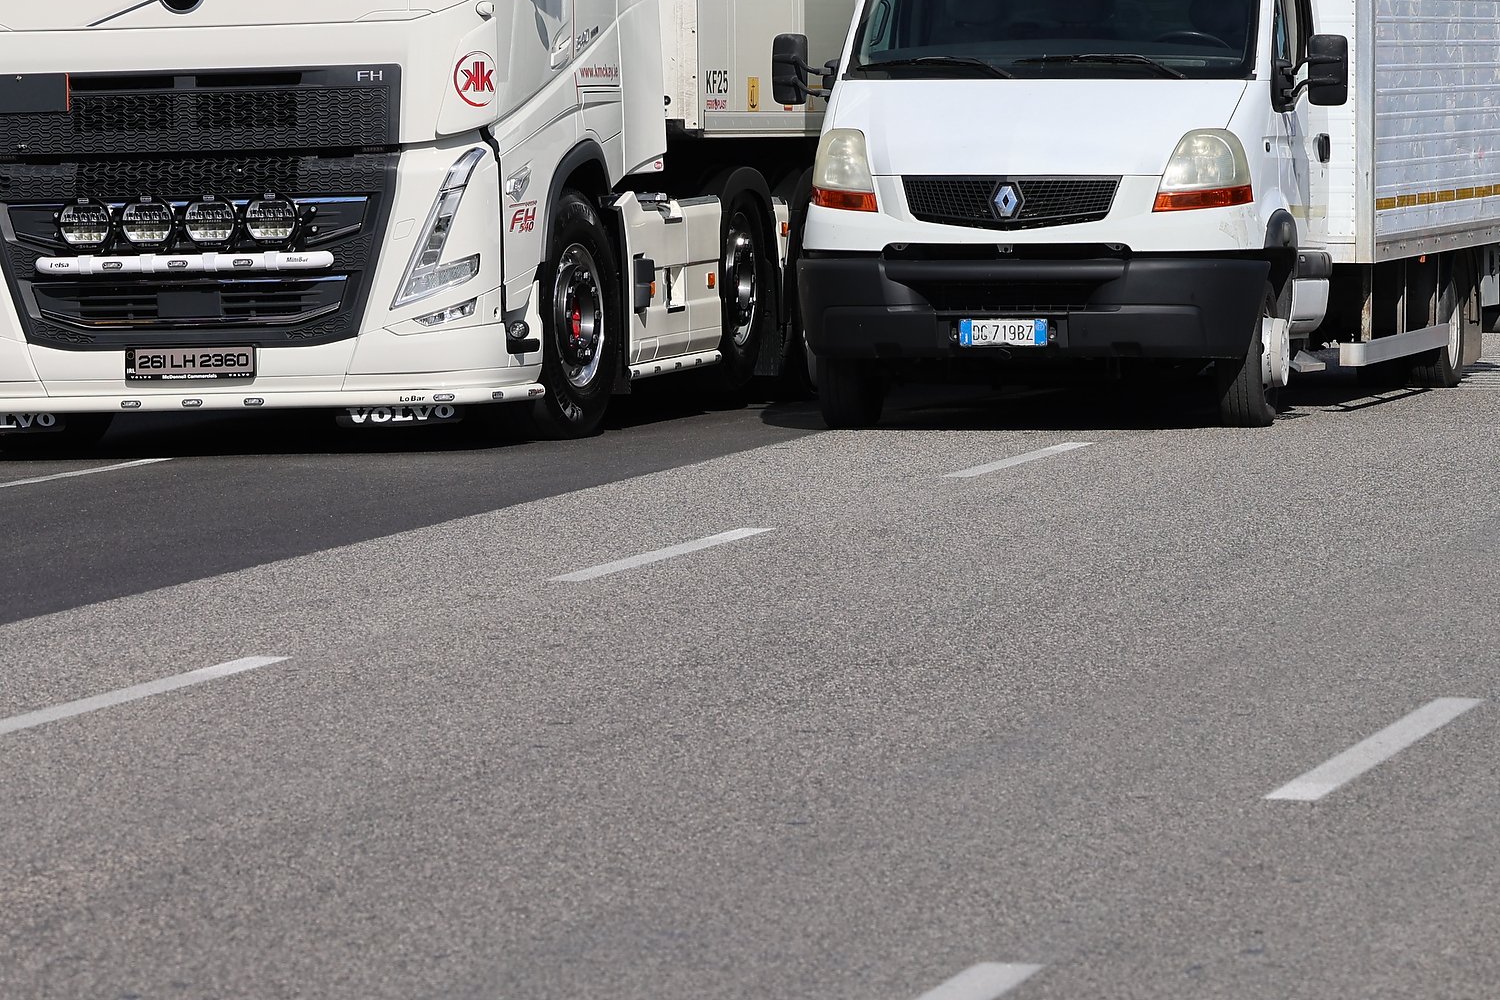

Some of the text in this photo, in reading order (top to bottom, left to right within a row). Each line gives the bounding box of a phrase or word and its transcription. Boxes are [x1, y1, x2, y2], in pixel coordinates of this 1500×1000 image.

[357, 70, 383, 82] FH
[705, 70, 729, 94] KF25
[508, 207, 537, 232] FH
[170, 354, 196, 368] LH
[199, 353, 249, 368] 2360
[345, 404, 456, 424] VOLVO
